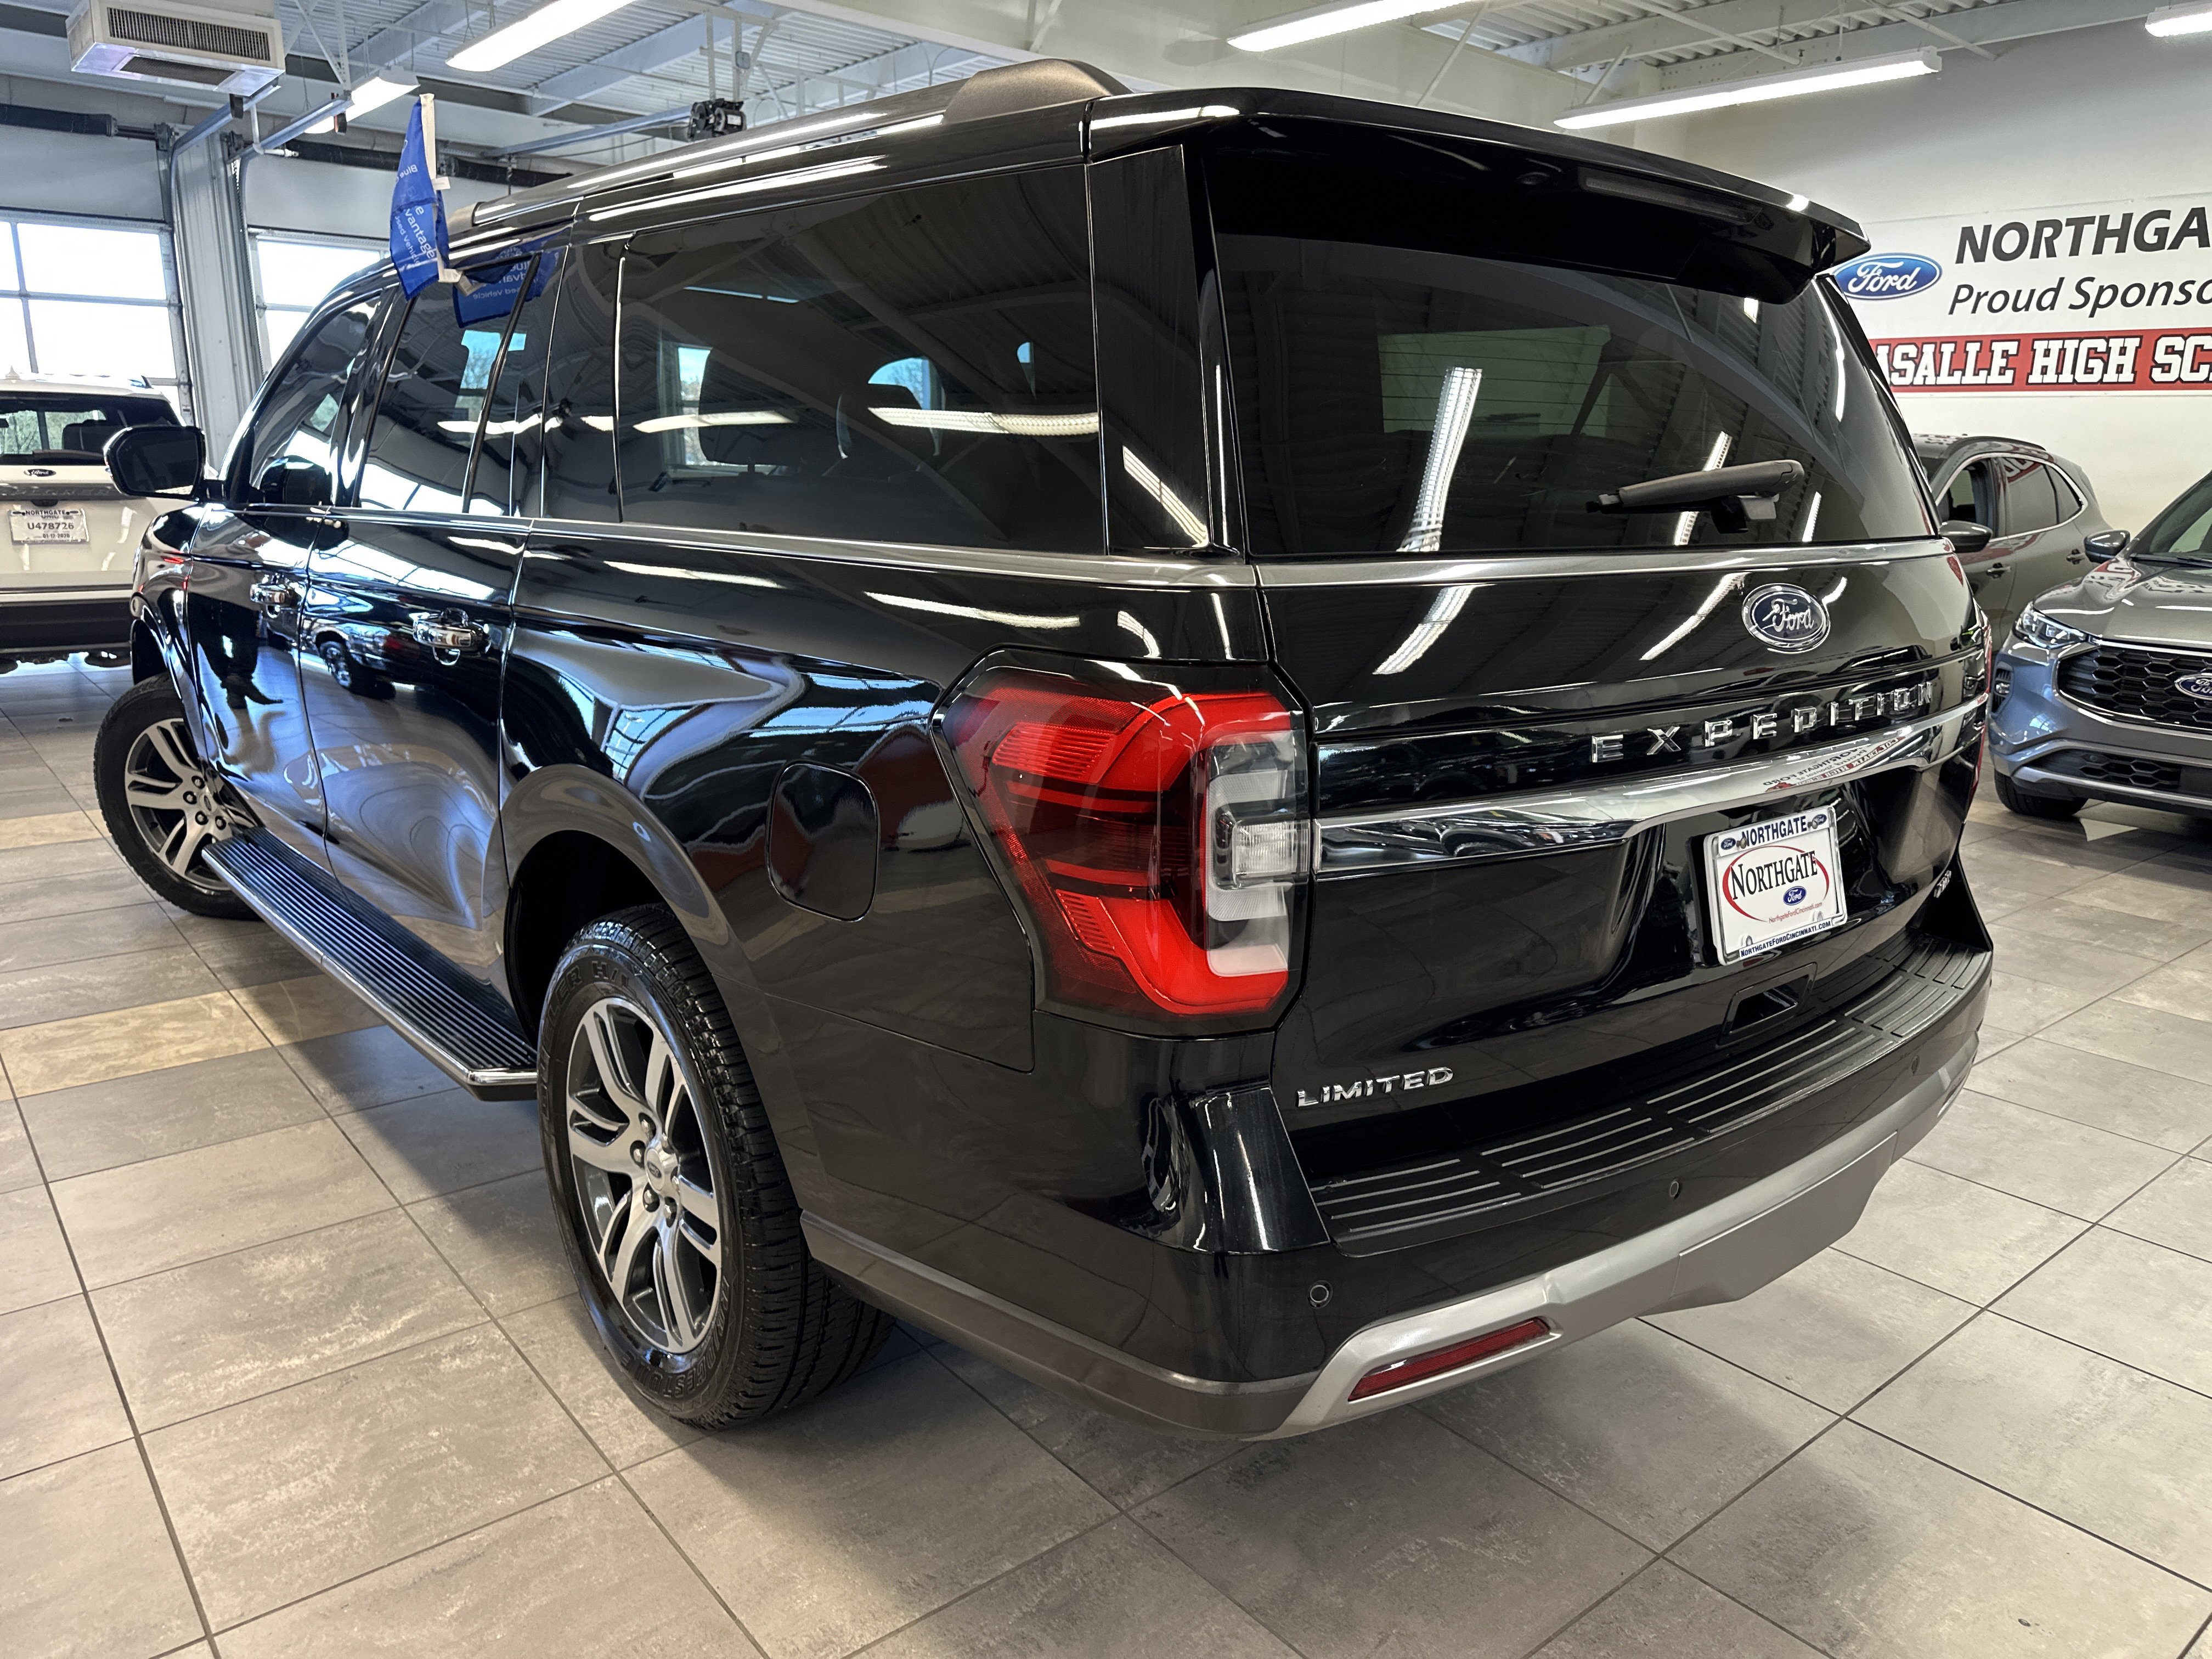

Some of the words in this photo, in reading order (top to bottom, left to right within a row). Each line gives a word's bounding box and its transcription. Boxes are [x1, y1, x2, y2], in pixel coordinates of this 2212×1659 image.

[1955, 206, 2211, 264] NORTHGA
[1847, 261, 1921, 294] Ford
[1948, 276, 2066, 315] Proud
[2026, 335, 2143, 386] HIGH
[2148, 333, 2212, 384] SC
[27, 522, 75, 530] U478726
[1762, 598, 1814, 633] Ford
[2191, 678, 2212, 694] Fo
[1591, 681, 1934, 764] EXPEDITION
[1741, 815, 1807, 847] NORTHGATE
[1730, 850, 1818, 900] NORTHGATE
[1787, 889, 1804, 903] Ford
[1295, 1066, 1454, 1108] LIMITED
